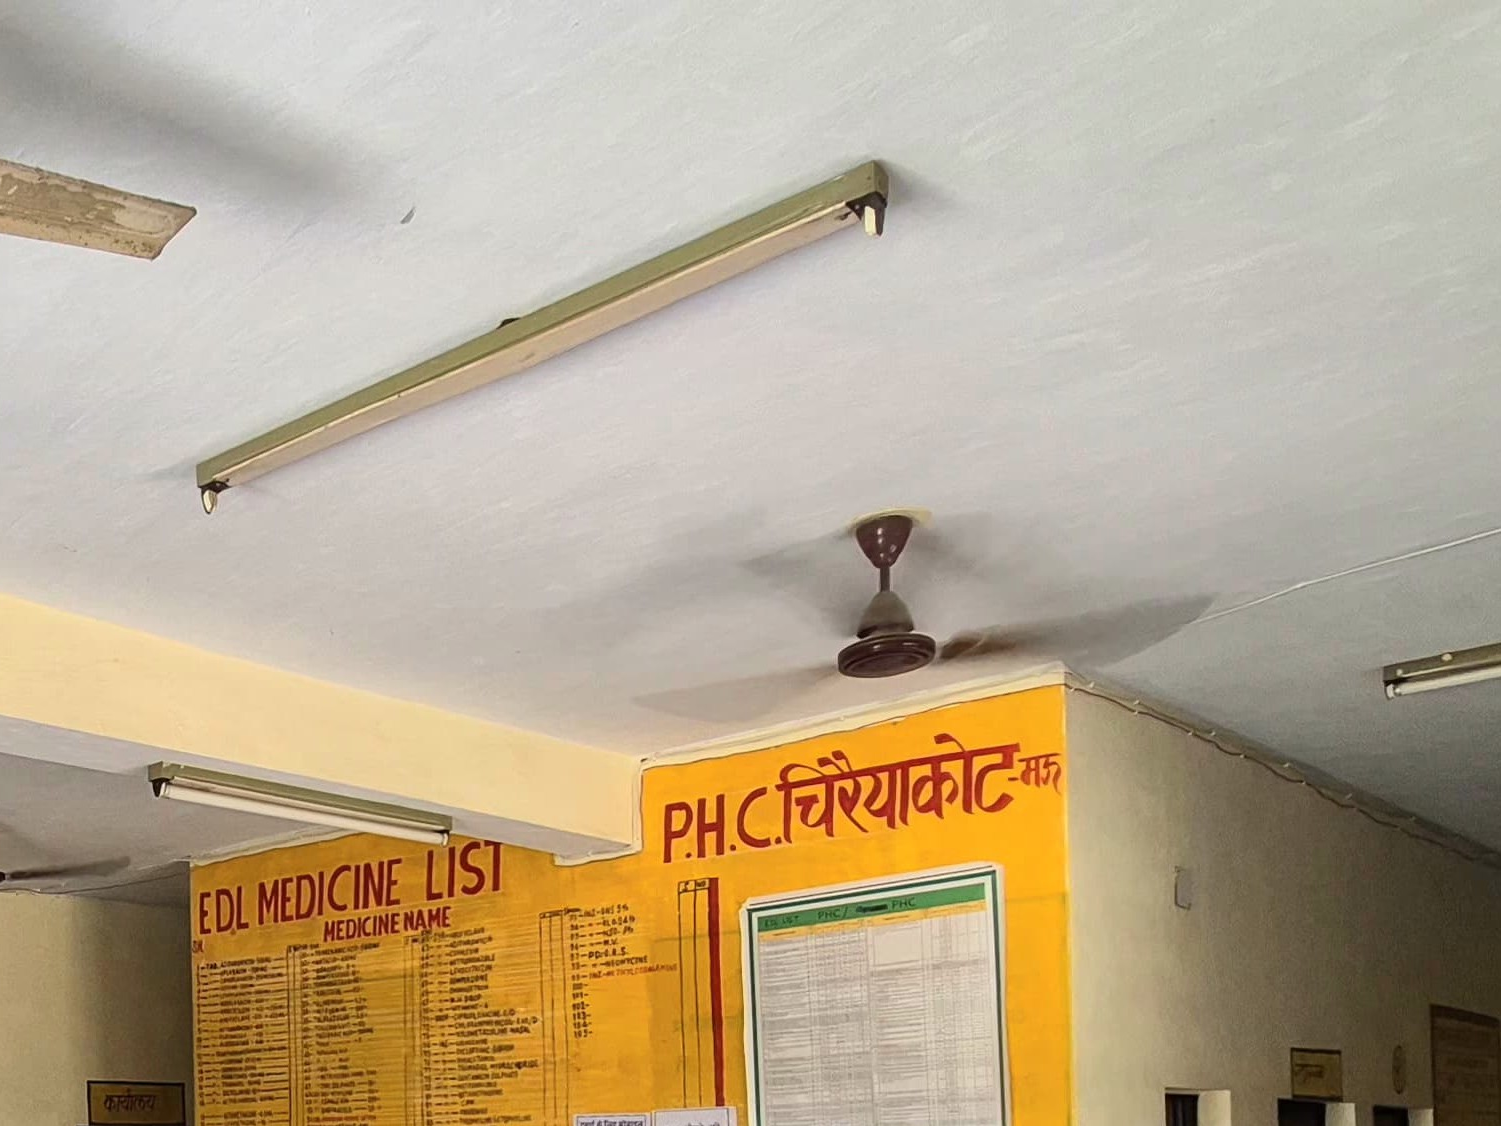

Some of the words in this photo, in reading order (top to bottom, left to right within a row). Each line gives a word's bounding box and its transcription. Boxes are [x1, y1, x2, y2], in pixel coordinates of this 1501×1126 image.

[663, 787, 782, 863] P.H.C.
[199, 886, 249, 934] EDL
[257, 858, 403, 925] MEDICINE
[426, 840, 503, 901] LIST
[323, 912, 400, 942] MEDICINE
[403, 906, 451, 932] NAME
